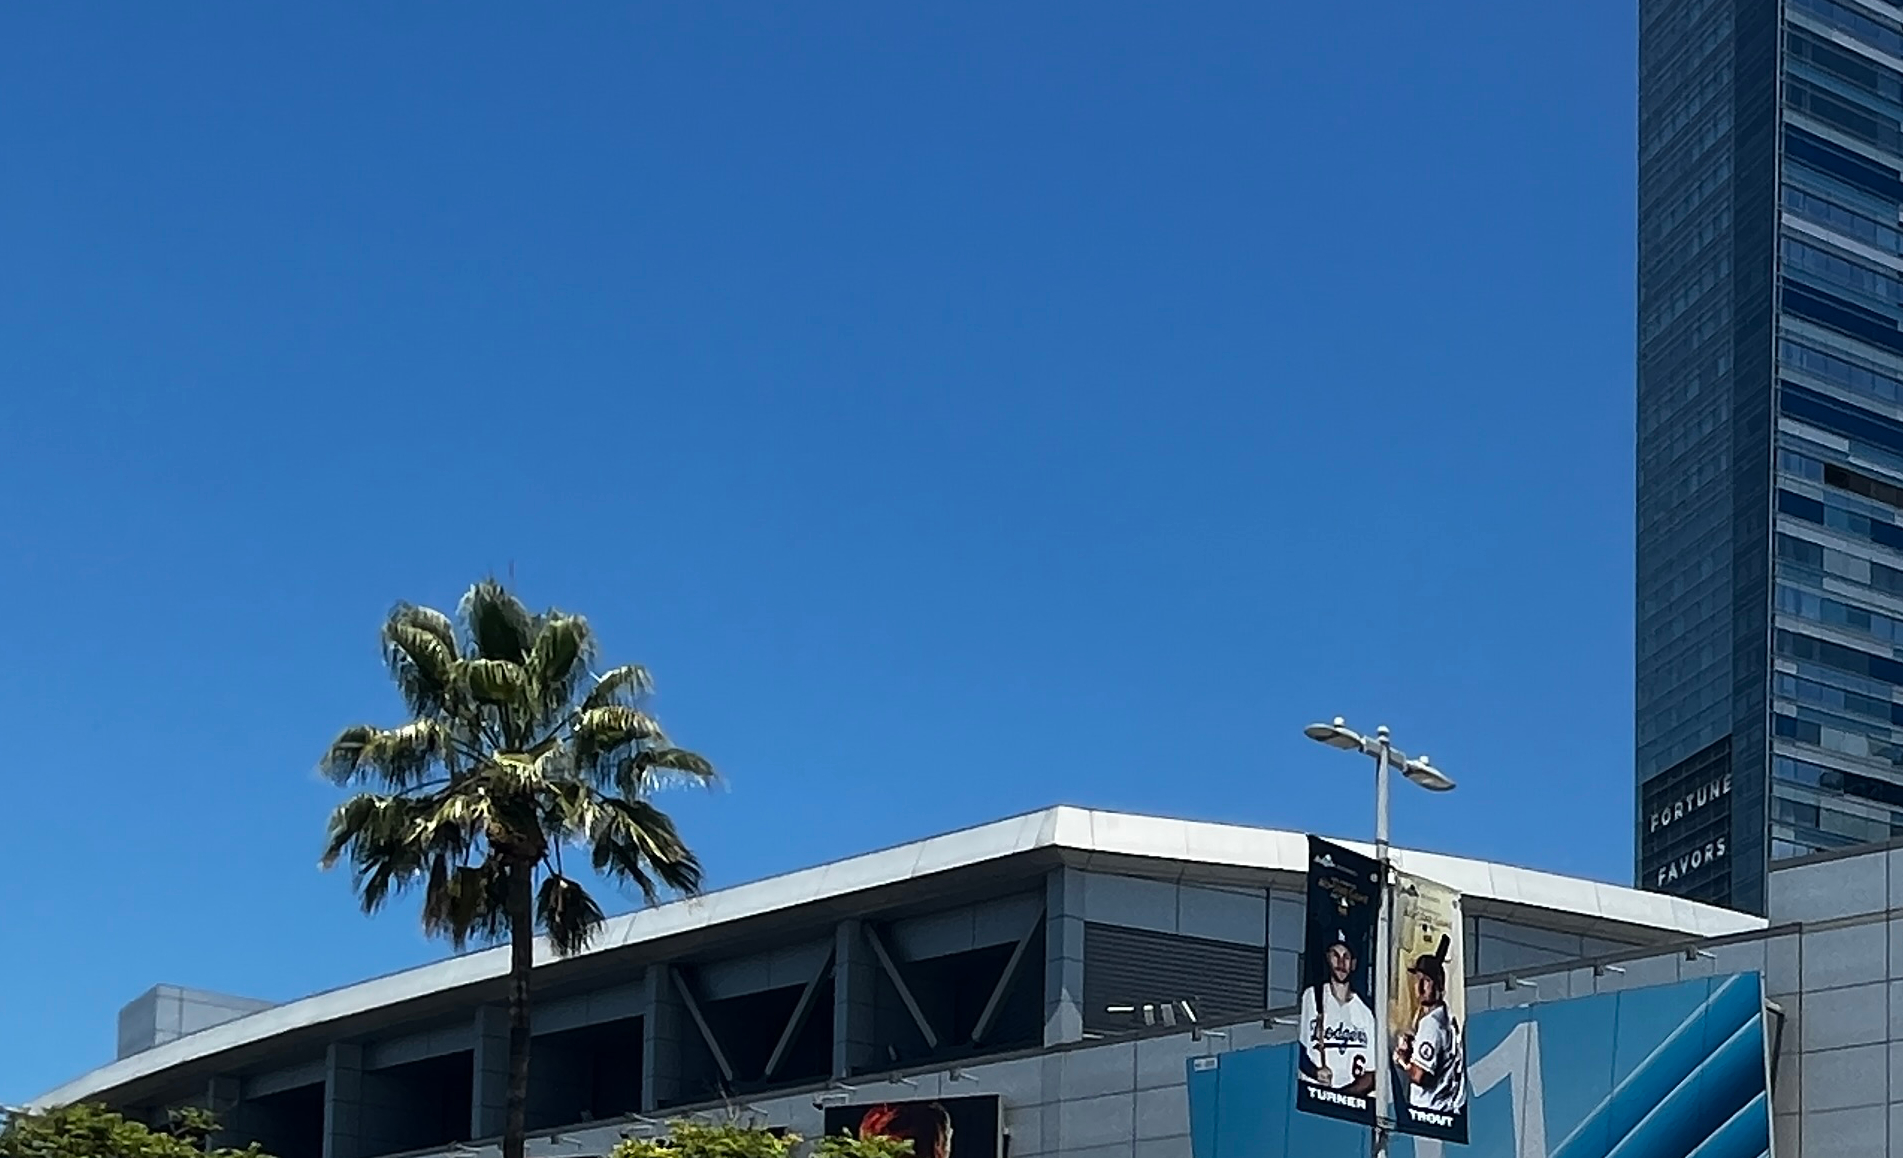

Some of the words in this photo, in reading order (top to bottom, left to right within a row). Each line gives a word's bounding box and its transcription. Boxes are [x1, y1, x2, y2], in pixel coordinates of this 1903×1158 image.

[1650, 773, 1733, 833] FORTUNE
[1658, 837, 1726, 887] FAVORS
[1351, 1054, 1366, 1078] 6
[1307, 1085, 1367, 1110] TURNER
[1408, 1107, 1454, 1127] TROUT
